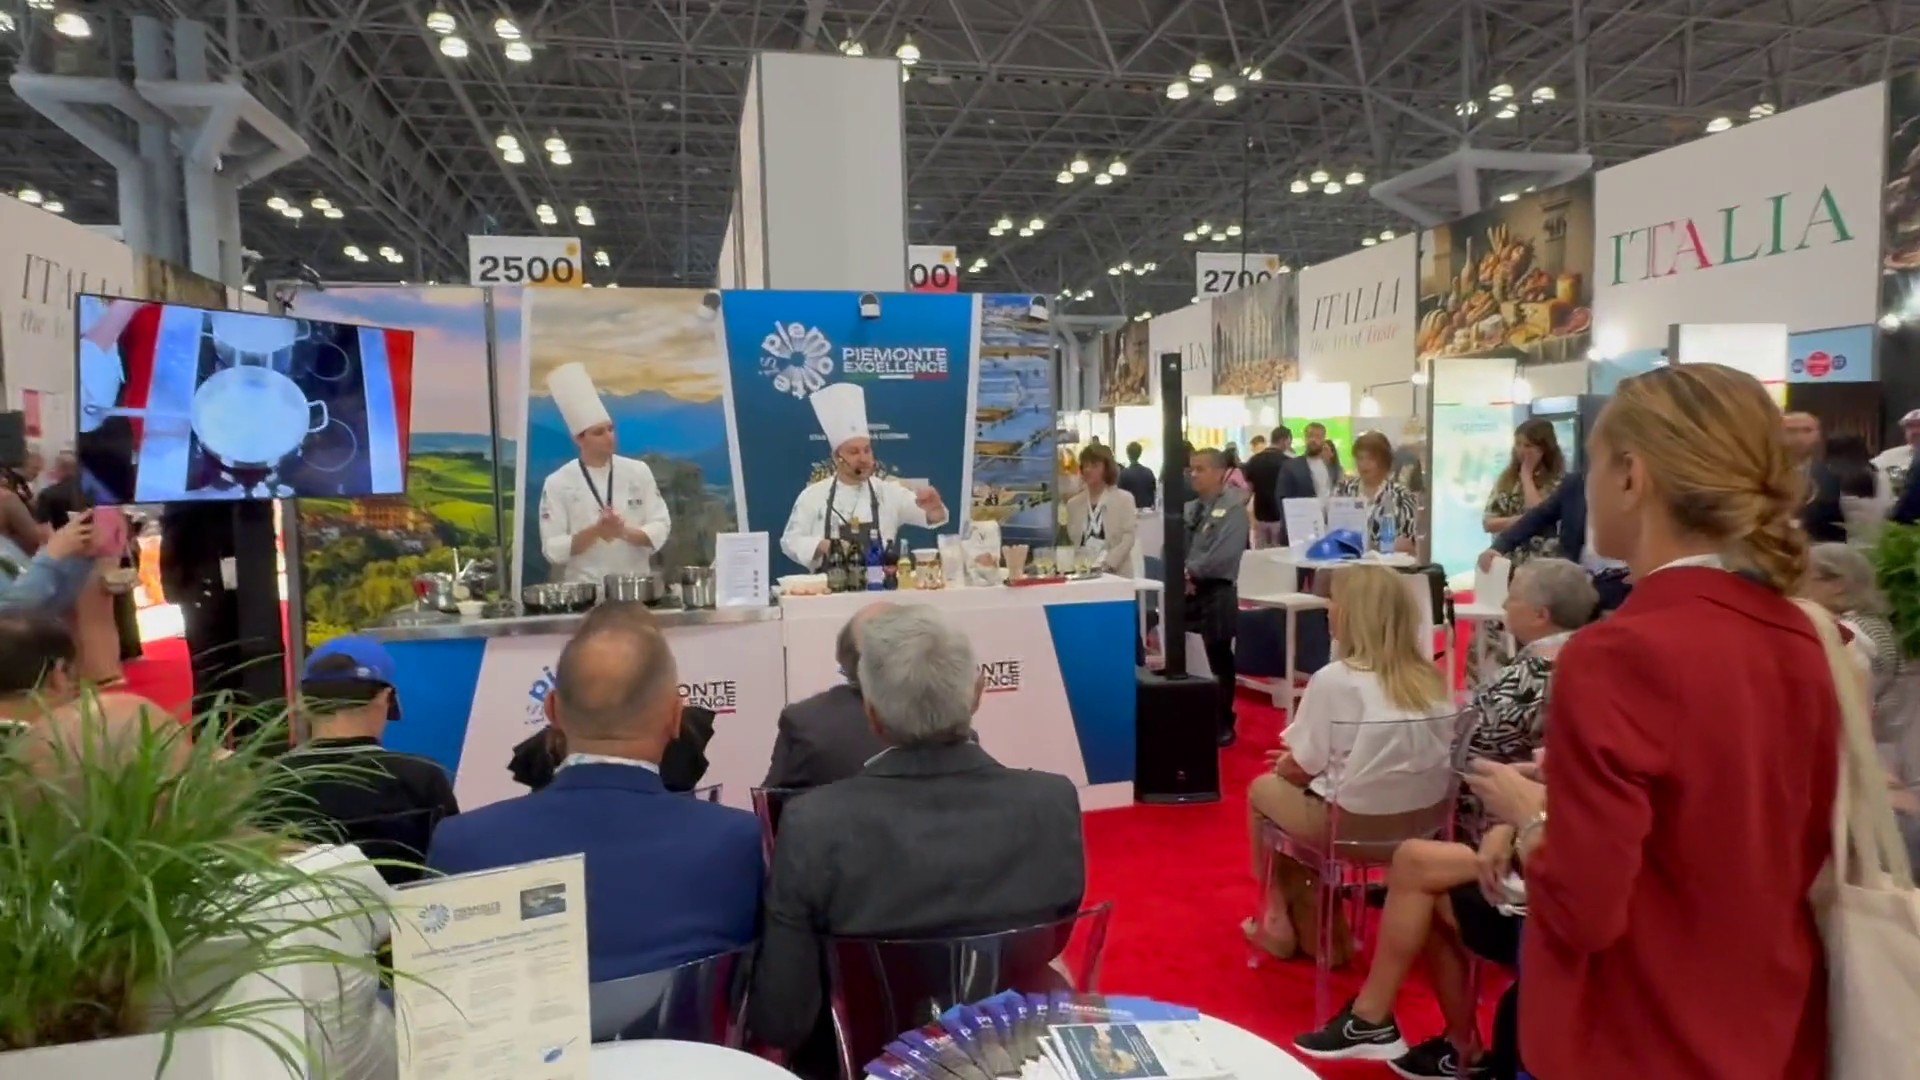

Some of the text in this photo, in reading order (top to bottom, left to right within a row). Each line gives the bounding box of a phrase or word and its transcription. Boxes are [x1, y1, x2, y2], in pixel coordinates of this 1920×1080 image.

[1609, 184, 1855, 286] ITALIA
[479, 256, 574, 283] 2500
[909, 263, 950, 288] 00
[1312, 277, 1401, 332] ITALIA
[842, 347, 948, 362] PIEMONTE
[843, 361, 948, 374] EXCELLENCE
[677, 680, 737, 697] ONTE
